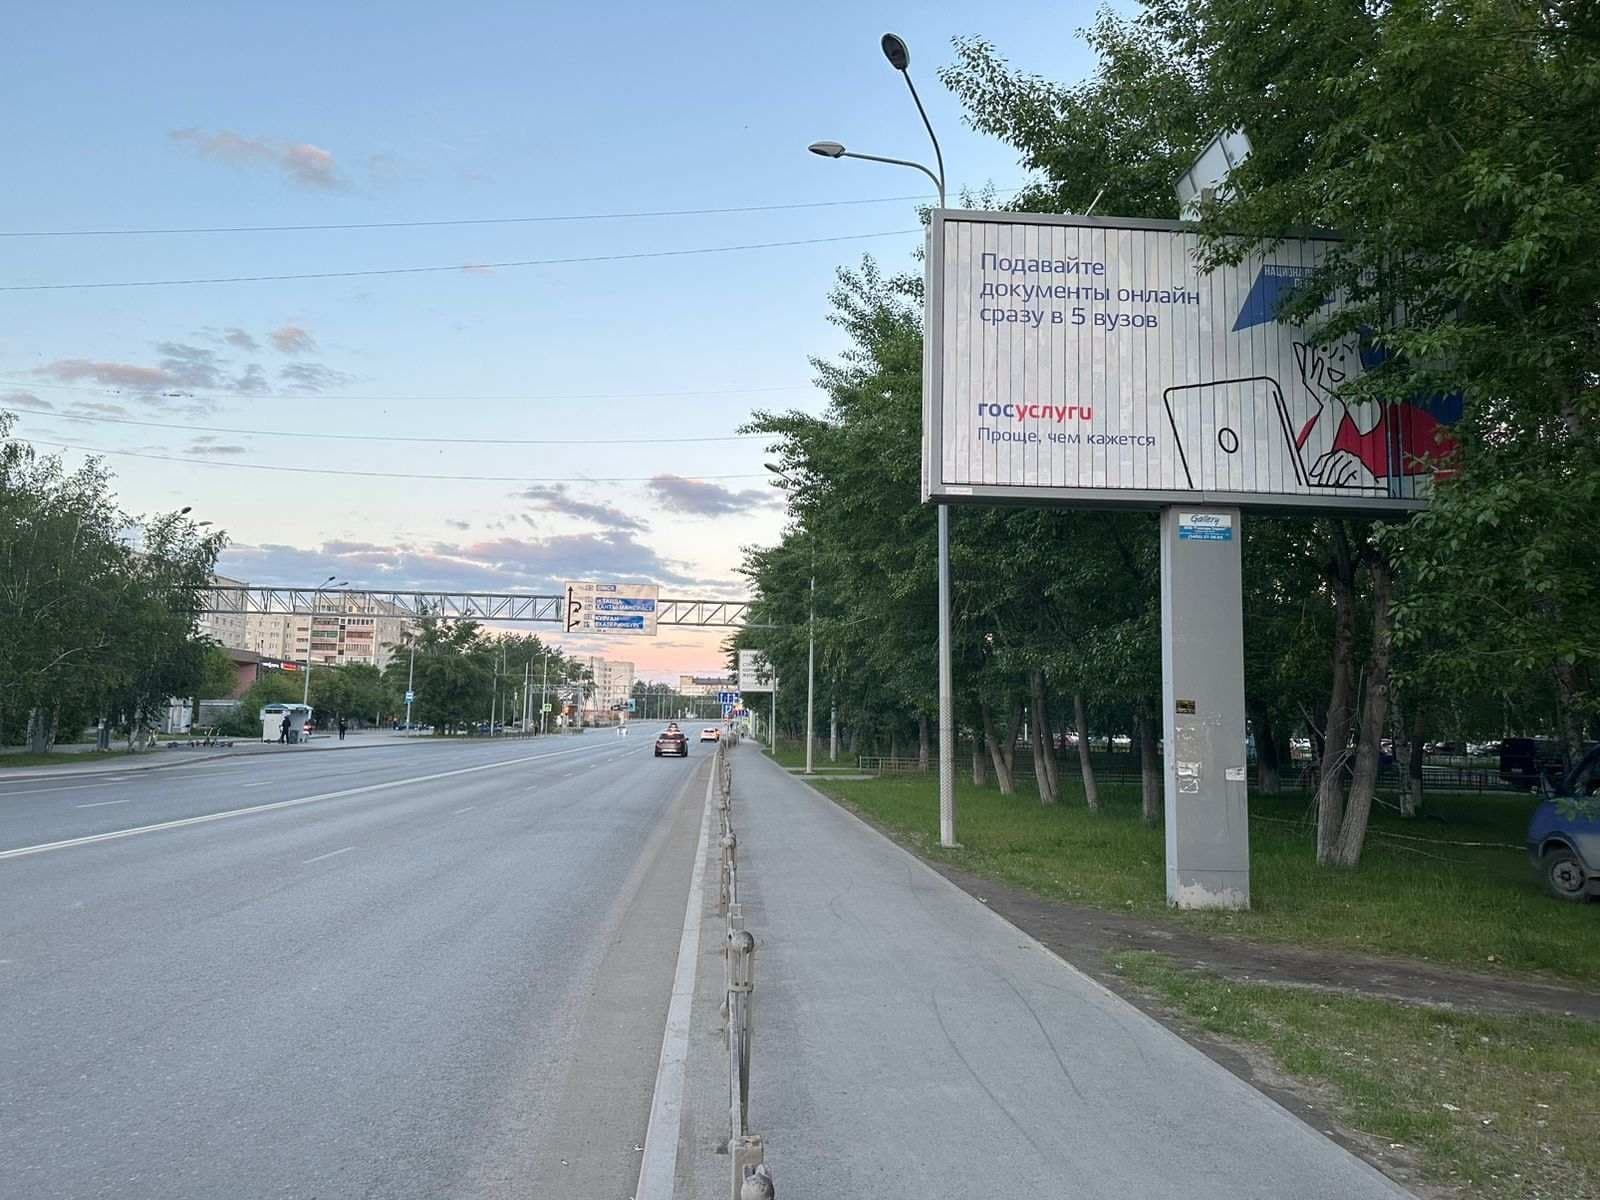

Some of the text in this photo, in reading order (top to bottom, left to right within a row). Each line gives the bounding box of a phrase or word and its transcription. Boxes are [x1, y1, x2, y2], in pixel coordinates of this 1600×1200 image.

[981, 253, 1104, 275] Подавайте
[980, 283, 1200, 304] документы онлайн
[980, 307, 1158, 331] сразу в 5 вузов
[978, 427, 1156, 446] Проще, чем кажется
